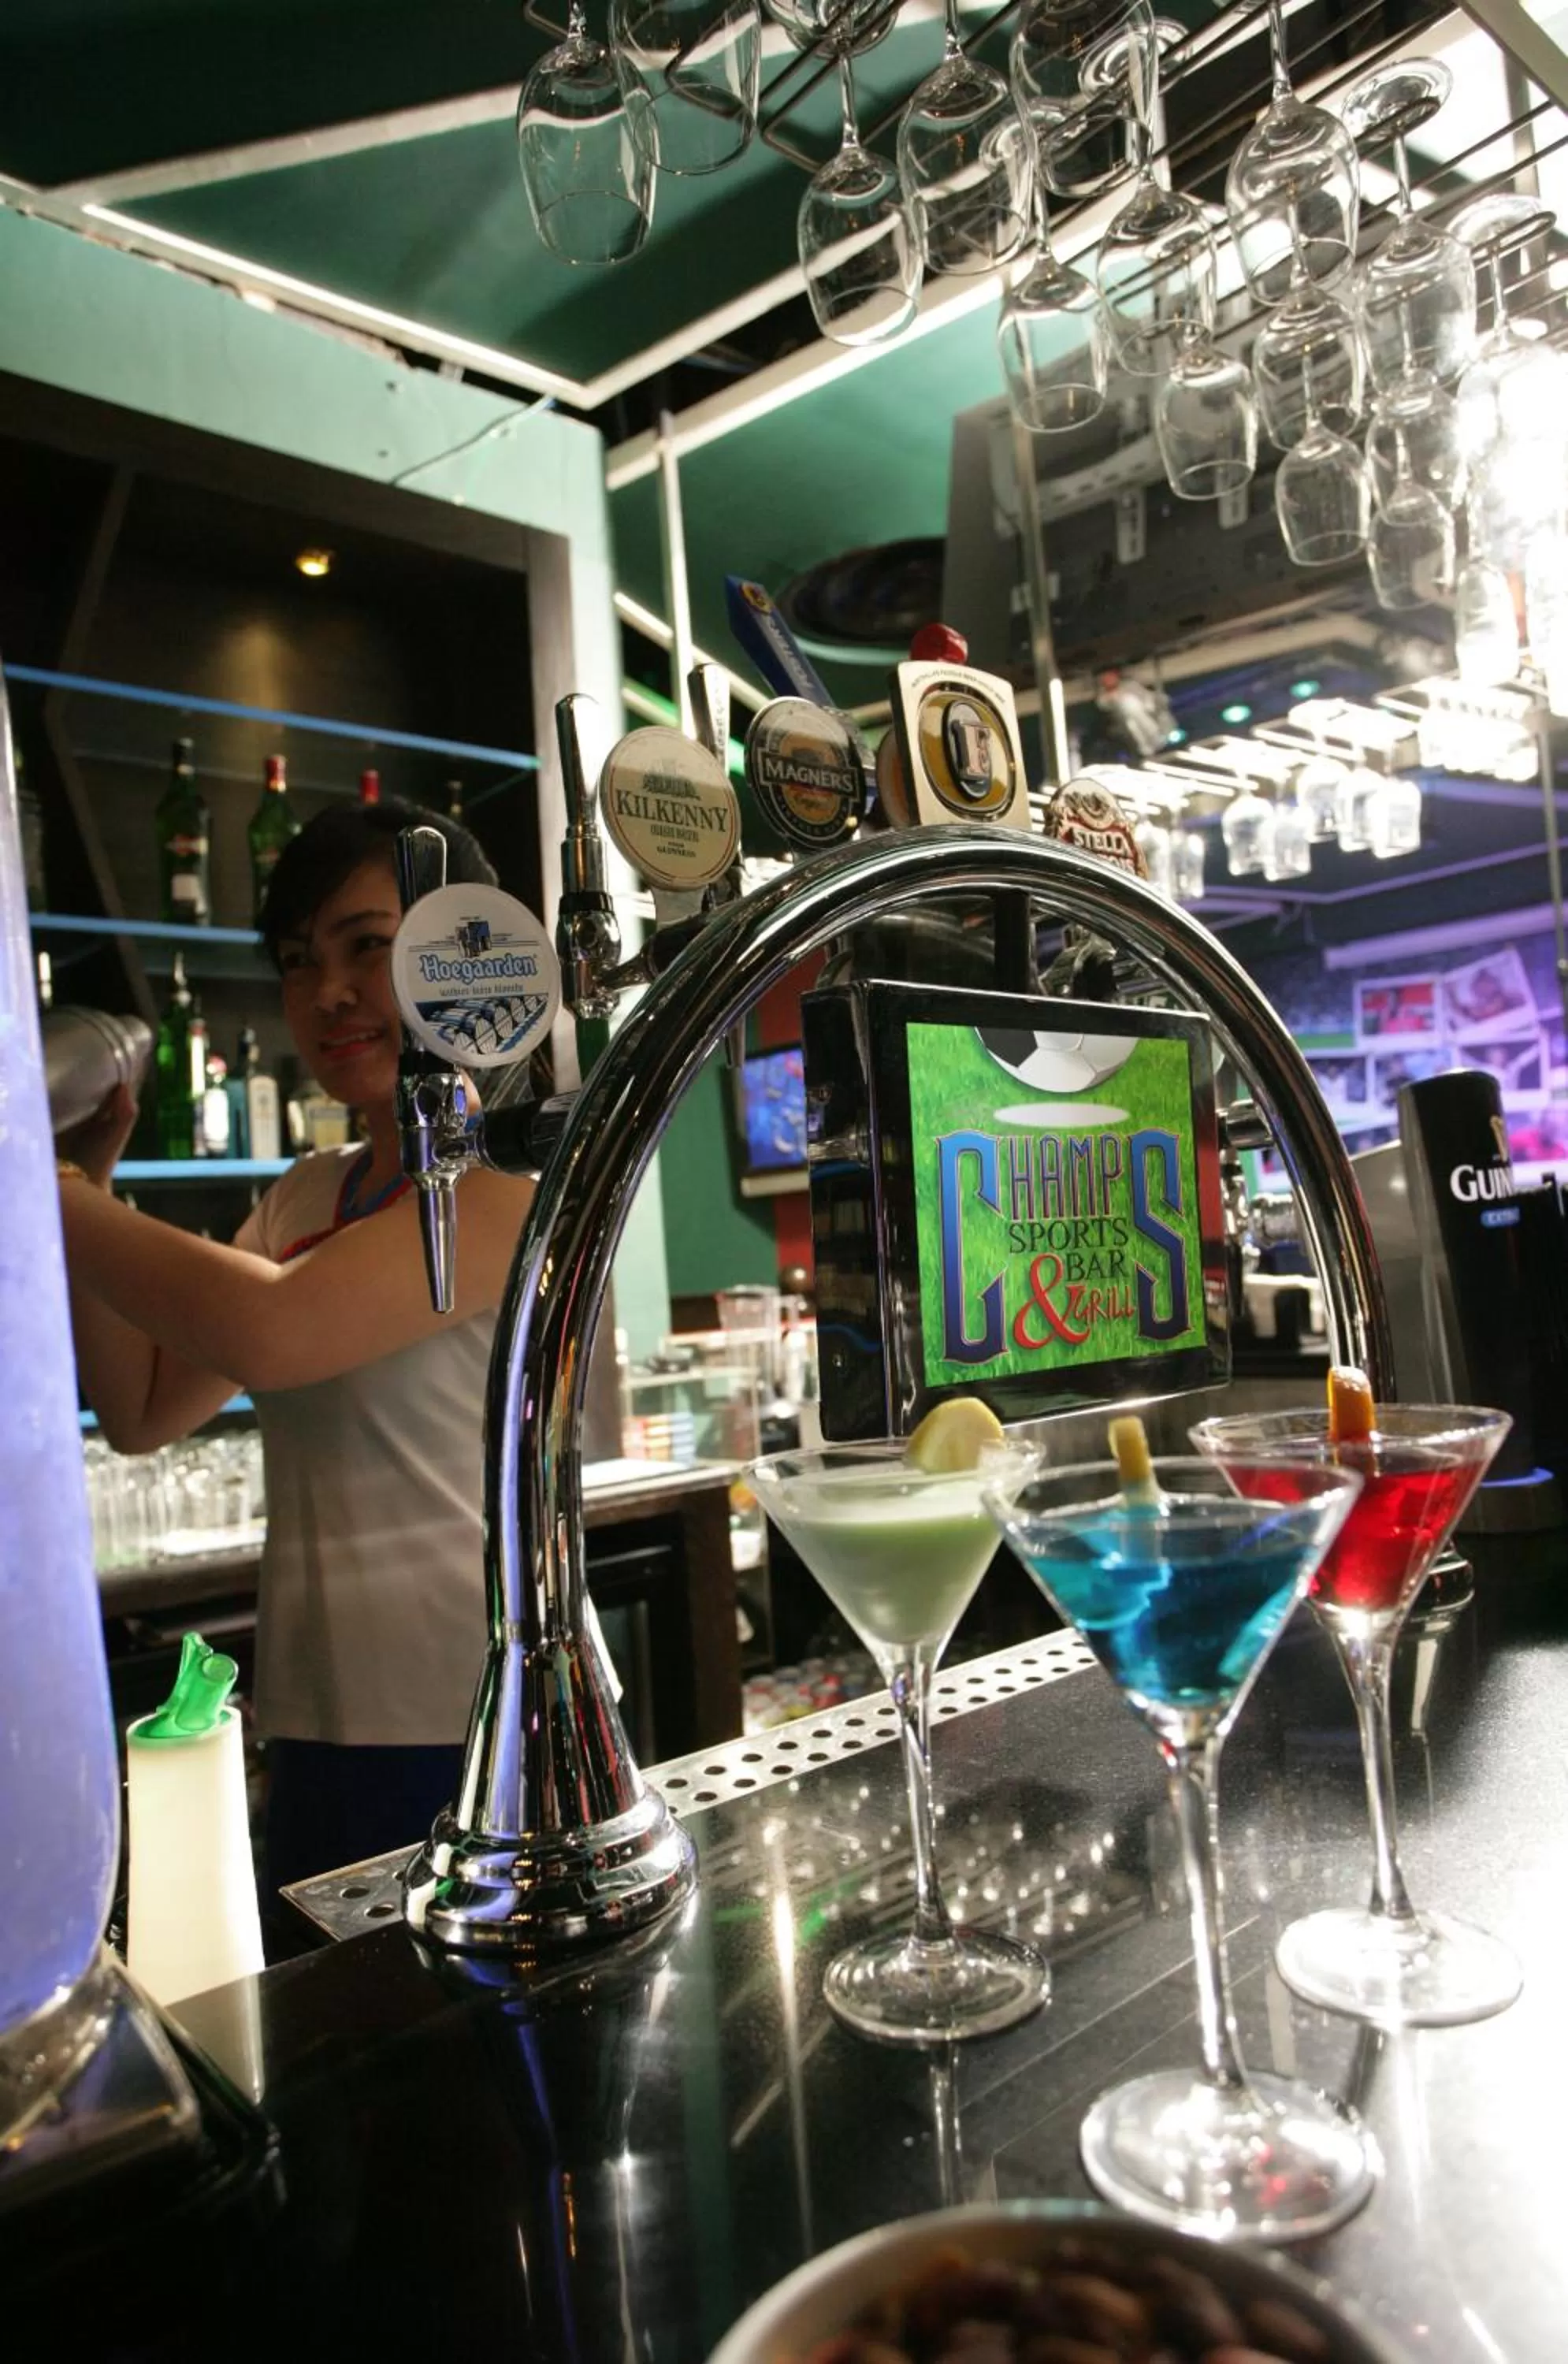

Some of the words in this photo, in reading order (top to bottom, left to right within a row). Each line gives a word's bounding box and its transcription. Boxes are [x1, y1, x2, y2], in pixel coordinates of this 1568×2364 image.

[766, 757, 853, 794] MAGNERS
[615, 789, 728, 832] KILKENNY
[1072, 828, 1135, 860] STELLA
[420, 953, 537, 984] Hoegaarden
[1450, 1165, 1513, 1202] GUIN
[934, 1128, 1194, 1365] CHAMPS
[1009, 1217, 1129, 1254] SPORTS
[1065, 1249, 1130, 1281] BAR
[1013, 1253, 1091, 1350] &
